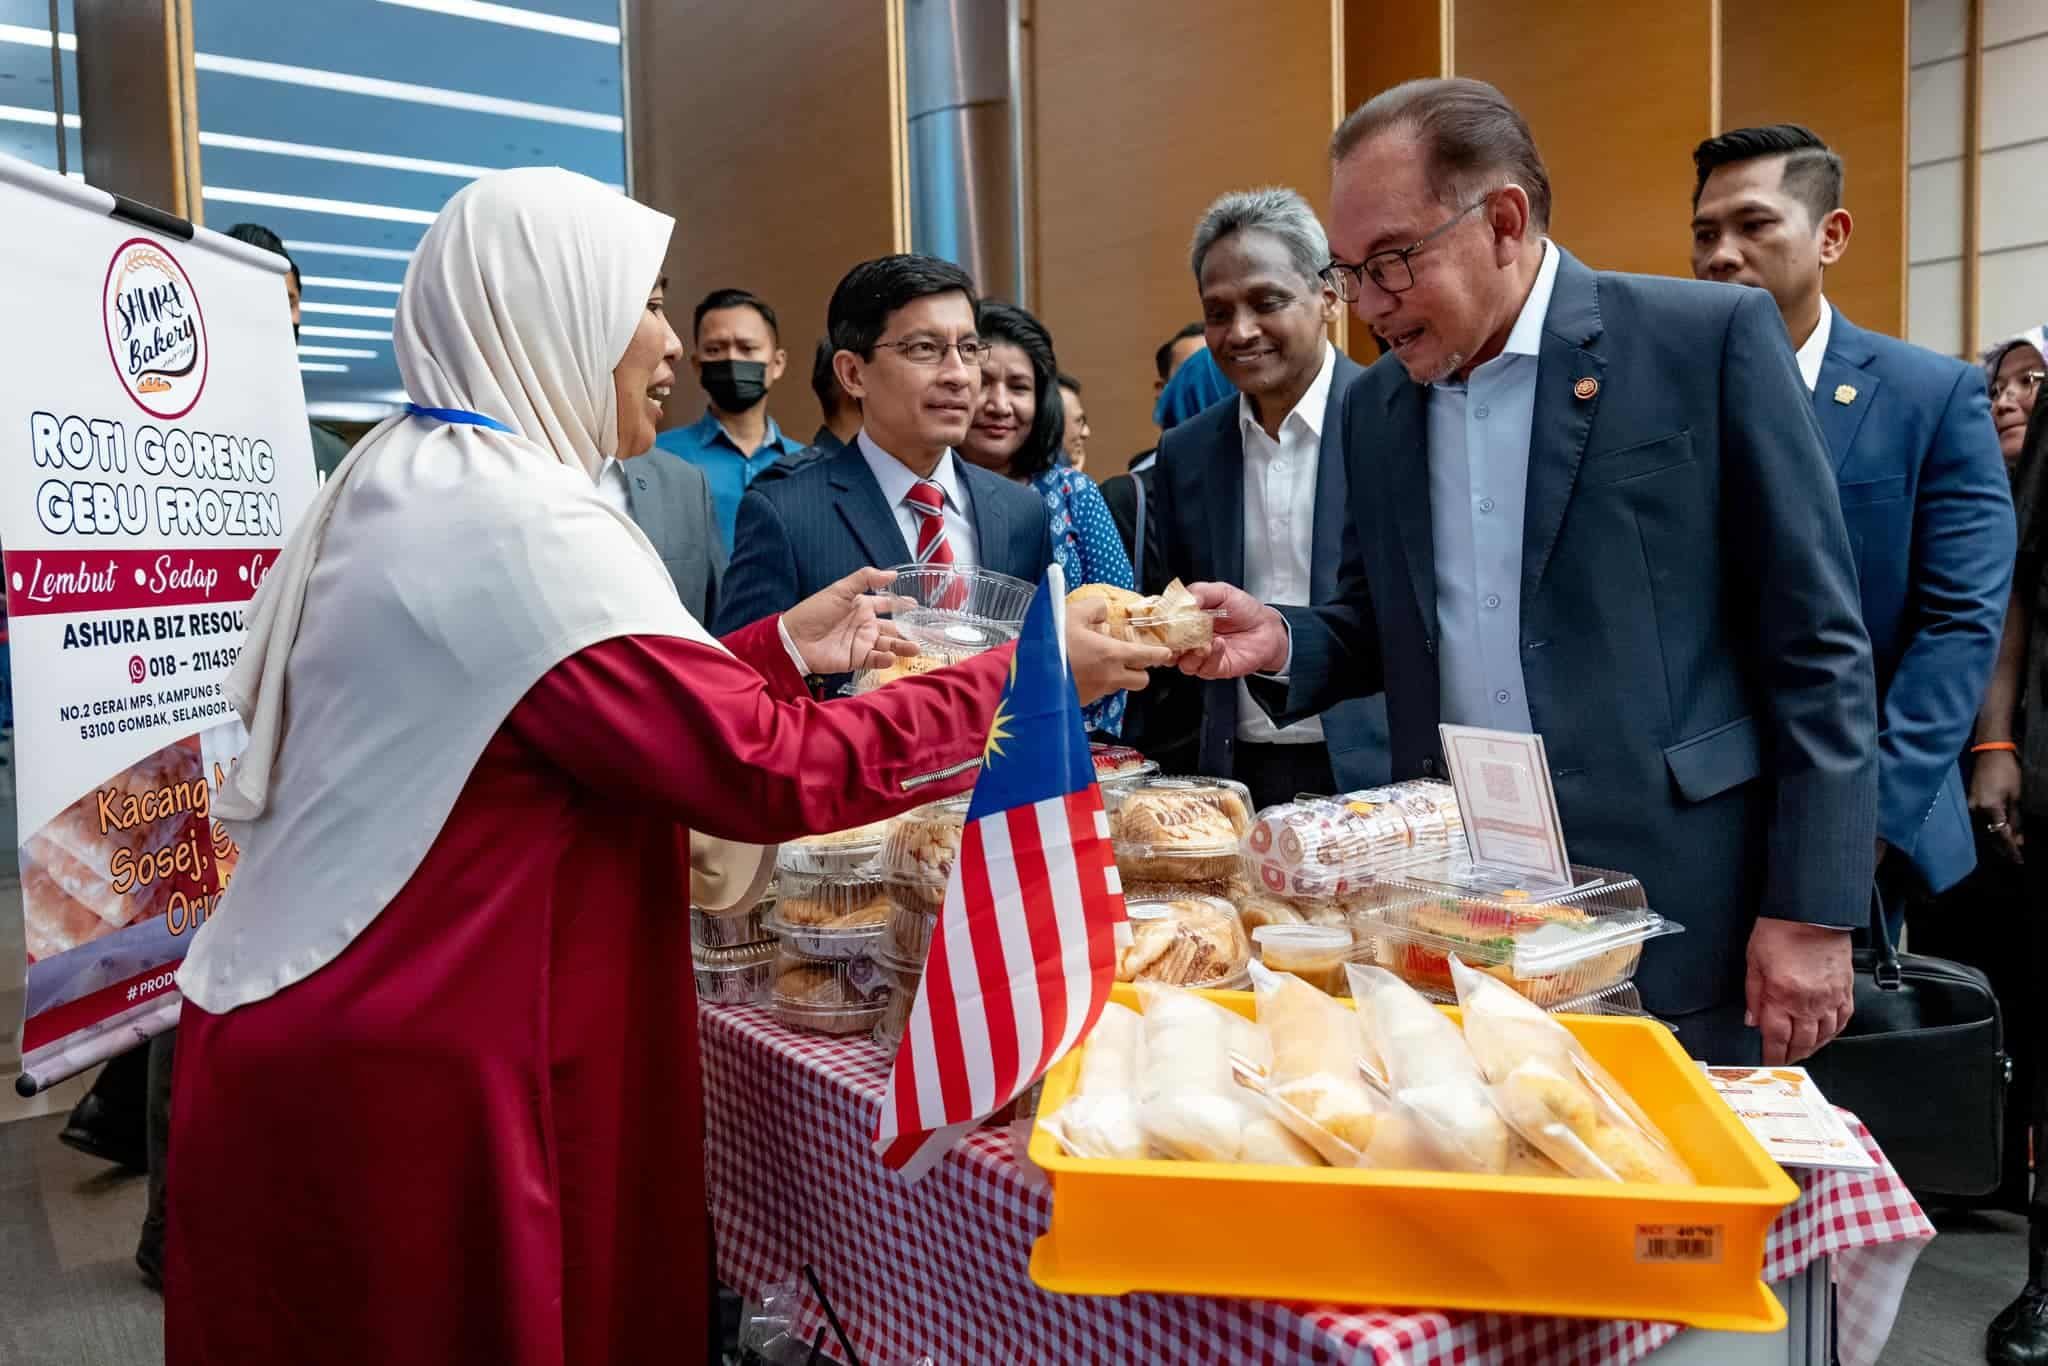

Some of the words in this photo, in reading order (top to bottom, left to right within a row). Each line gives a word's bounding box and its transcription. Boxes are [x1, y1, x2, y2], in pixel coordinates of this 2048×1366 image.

[129, 313, 198, 375] Bakery
[31, 411, 127, 473] ROTI
[135, 425, 275, 483] GORENG
[37, 479, 148, 535] GEBU
[155, 486, 282, 536] FROZEN
[28, 558, 119, 602] Lembut
[150, 554, 218, 597] Sedap
[63, 618, 150, 649] ASHURA
[153, 615, 186, 640] BIZ
[189, 610, 248, 636] RESOU
[150, 654, 176, 677] 018
[60, 703, 91, 722] NO.2
[93, 697, 127, 716] GERAI
[130, 693, 156, 709] MPS,
[158, 684, 213, 704] KAMPUNG
[80, 721, 115, 740] 53100
[118, 712, 171, 732] GOMBAK,
[172, 701, 227, 722] SELANGOR
[97, 776, 210, 834] Kacang
[111, 828, 208, 894] Sosej,
